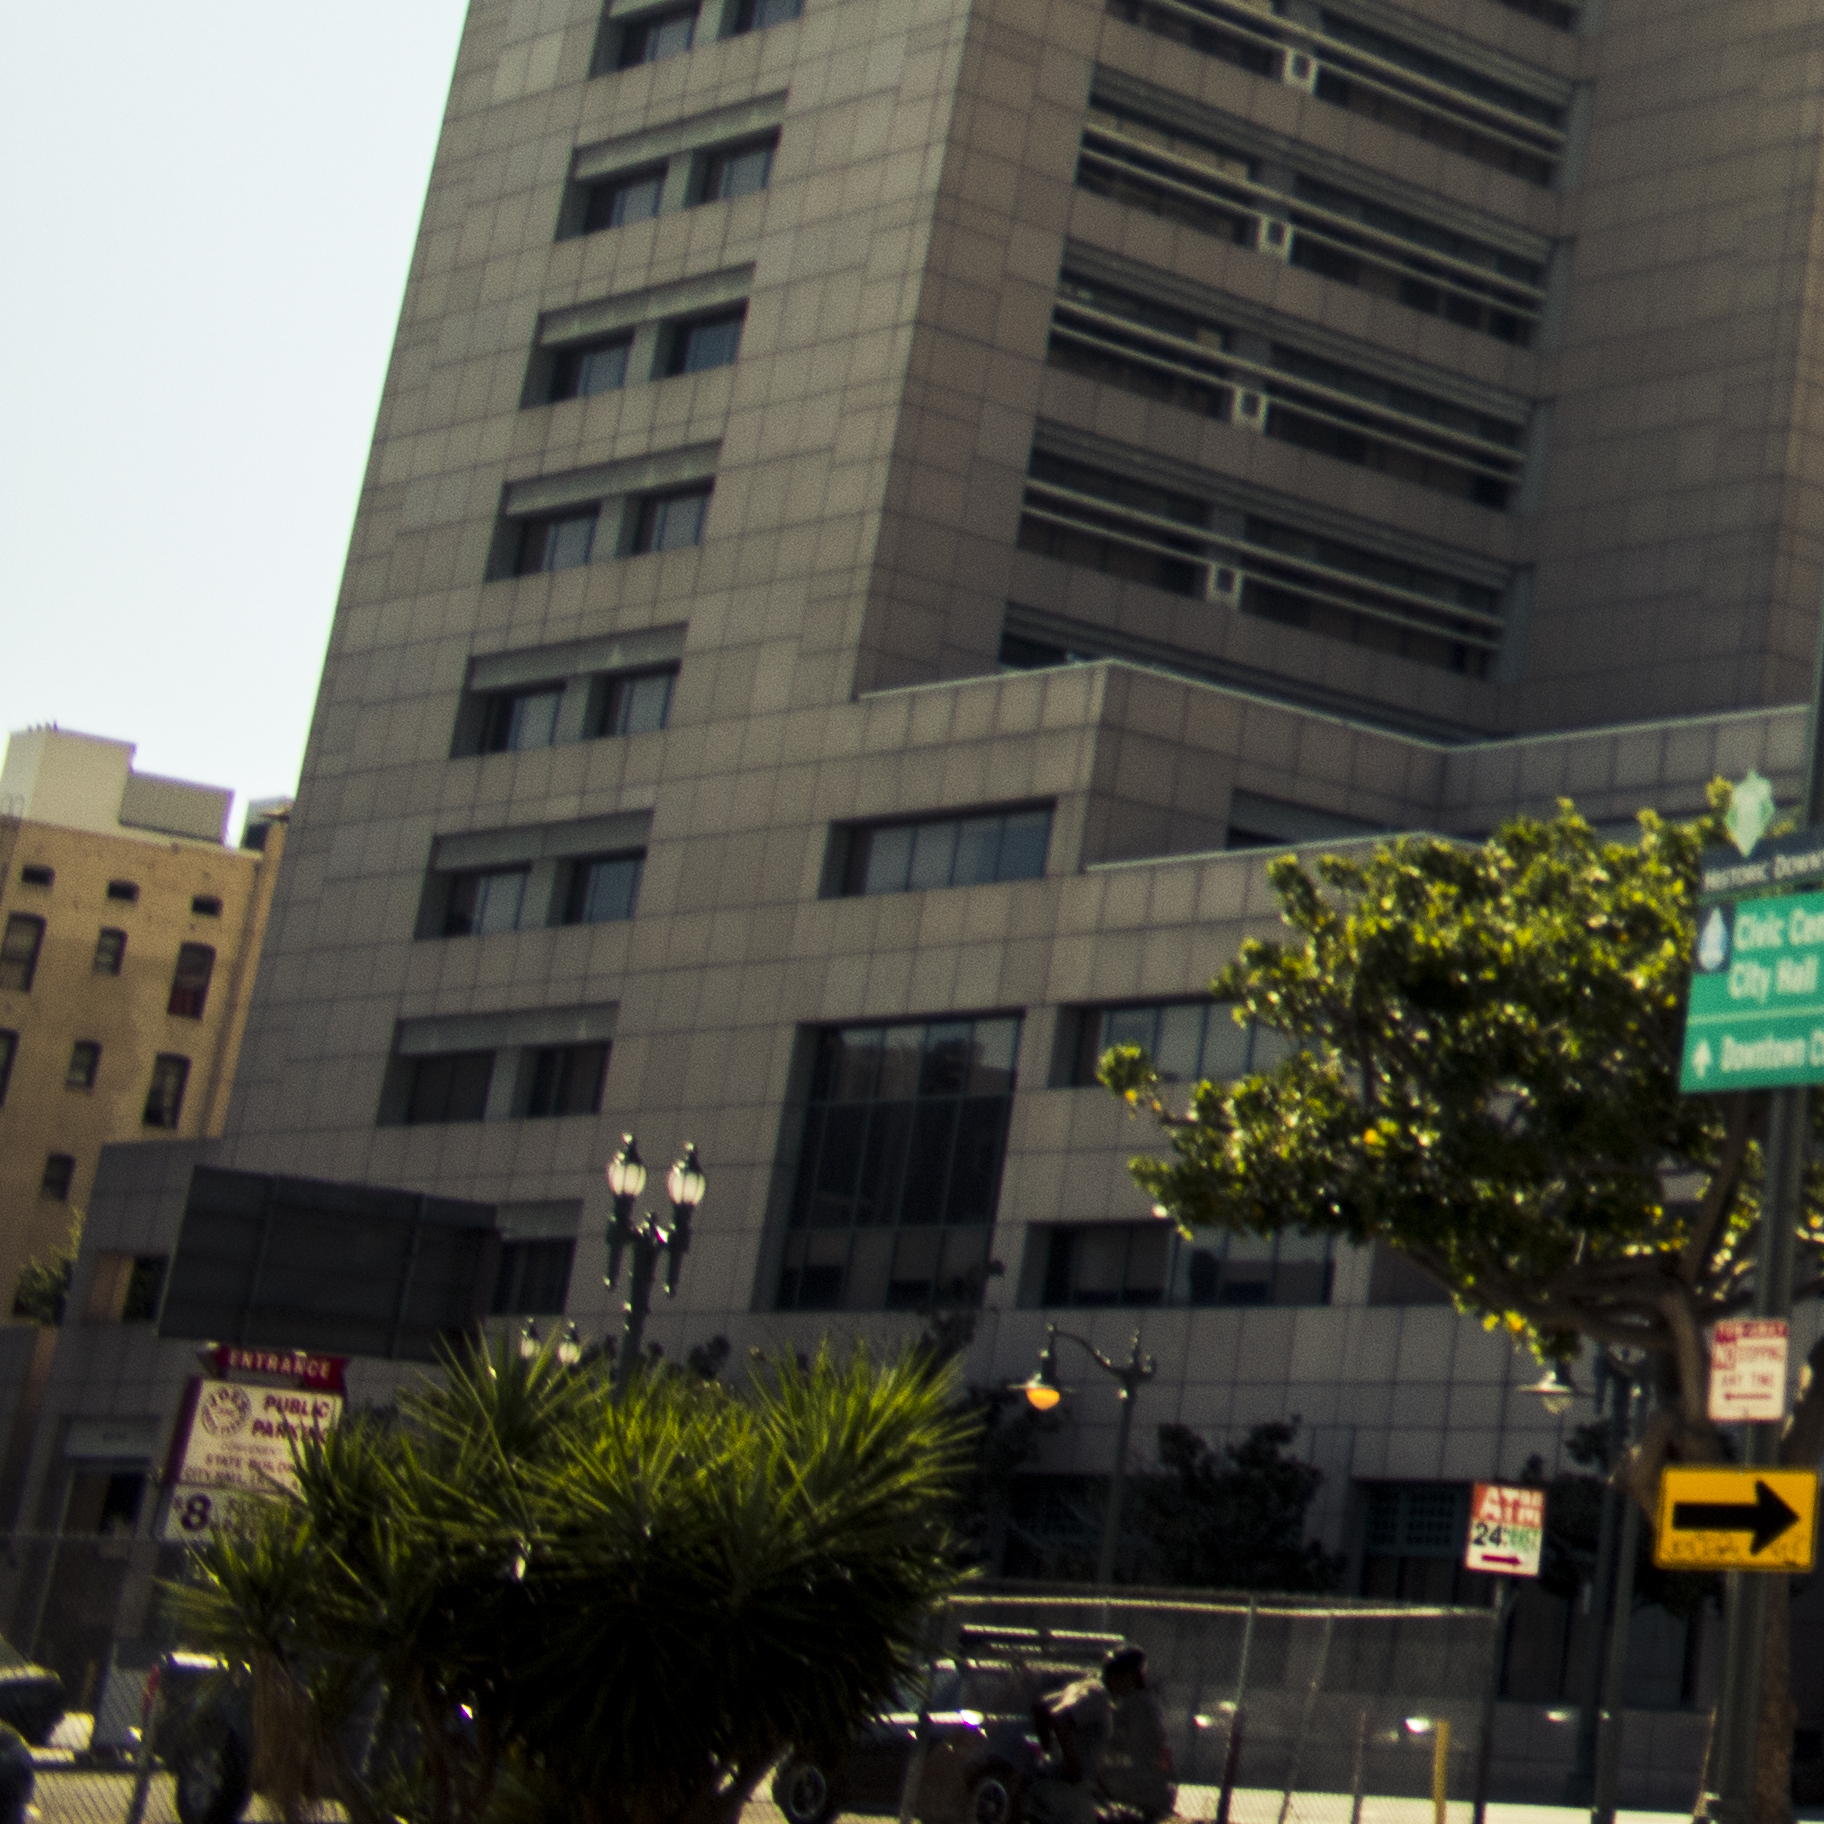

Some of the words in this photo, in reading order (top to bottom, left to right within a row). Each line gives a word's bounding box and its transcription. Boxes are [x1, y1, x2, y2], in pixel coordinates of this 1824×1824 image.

[1733, 914, 1784, 950] Civic
[1728, 962, 1772, 1004] City
[1777, 956, 1819, 994] Hall
[1720, 1035, 1807, 1072] Downtown
[229, 1350, 331, 1379] ENTRANCE
[264, 1394, 330, 1418] PUBLIC
